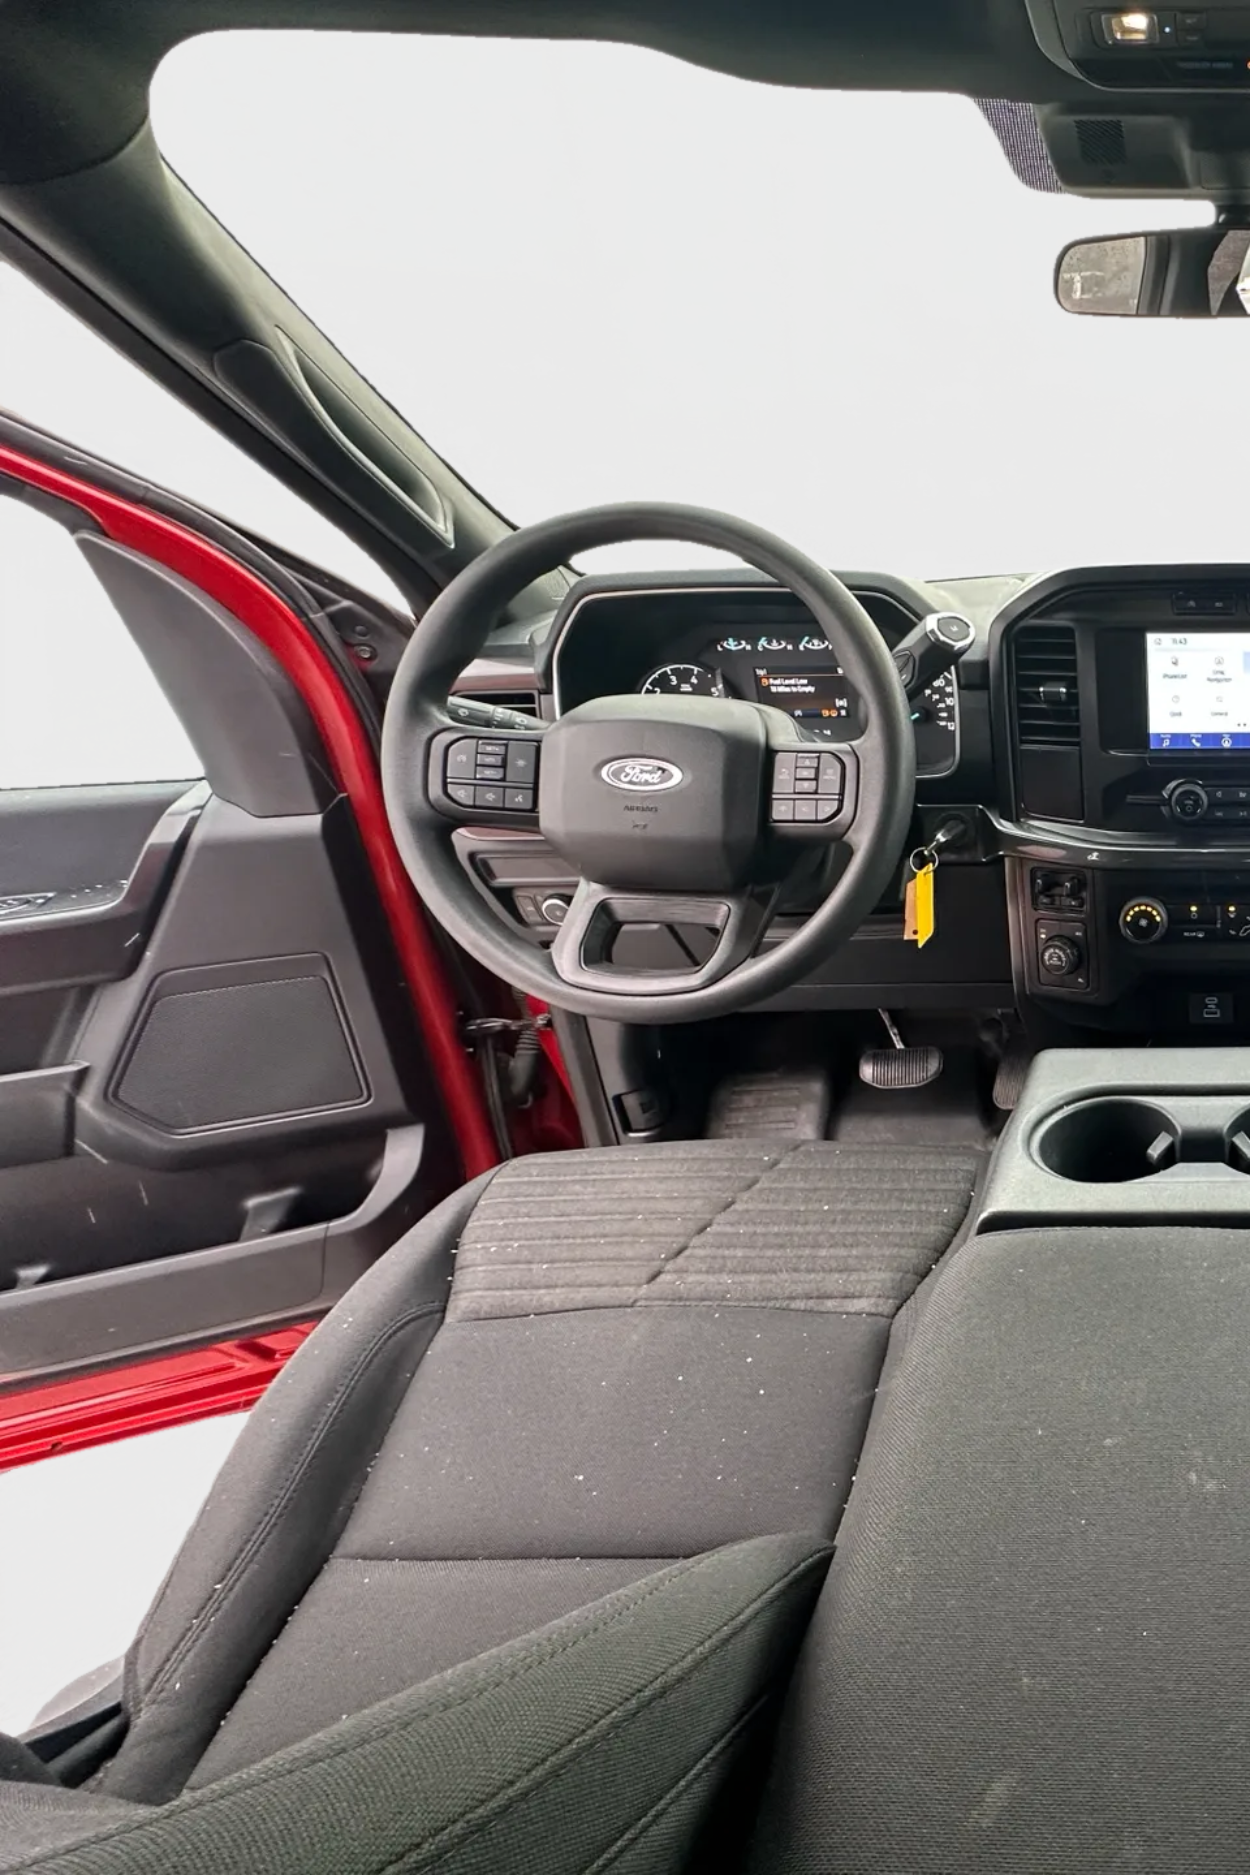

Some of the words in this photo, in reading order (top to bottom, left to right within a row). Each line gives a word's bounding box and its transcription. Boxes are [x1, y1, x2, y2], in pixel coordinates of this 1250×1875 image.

[669, 675, 677, 685] 3
[690, 675, 698, 684] 4
[711, 687, 719, 696] 5
[620, 765, 662, 783] Ford
